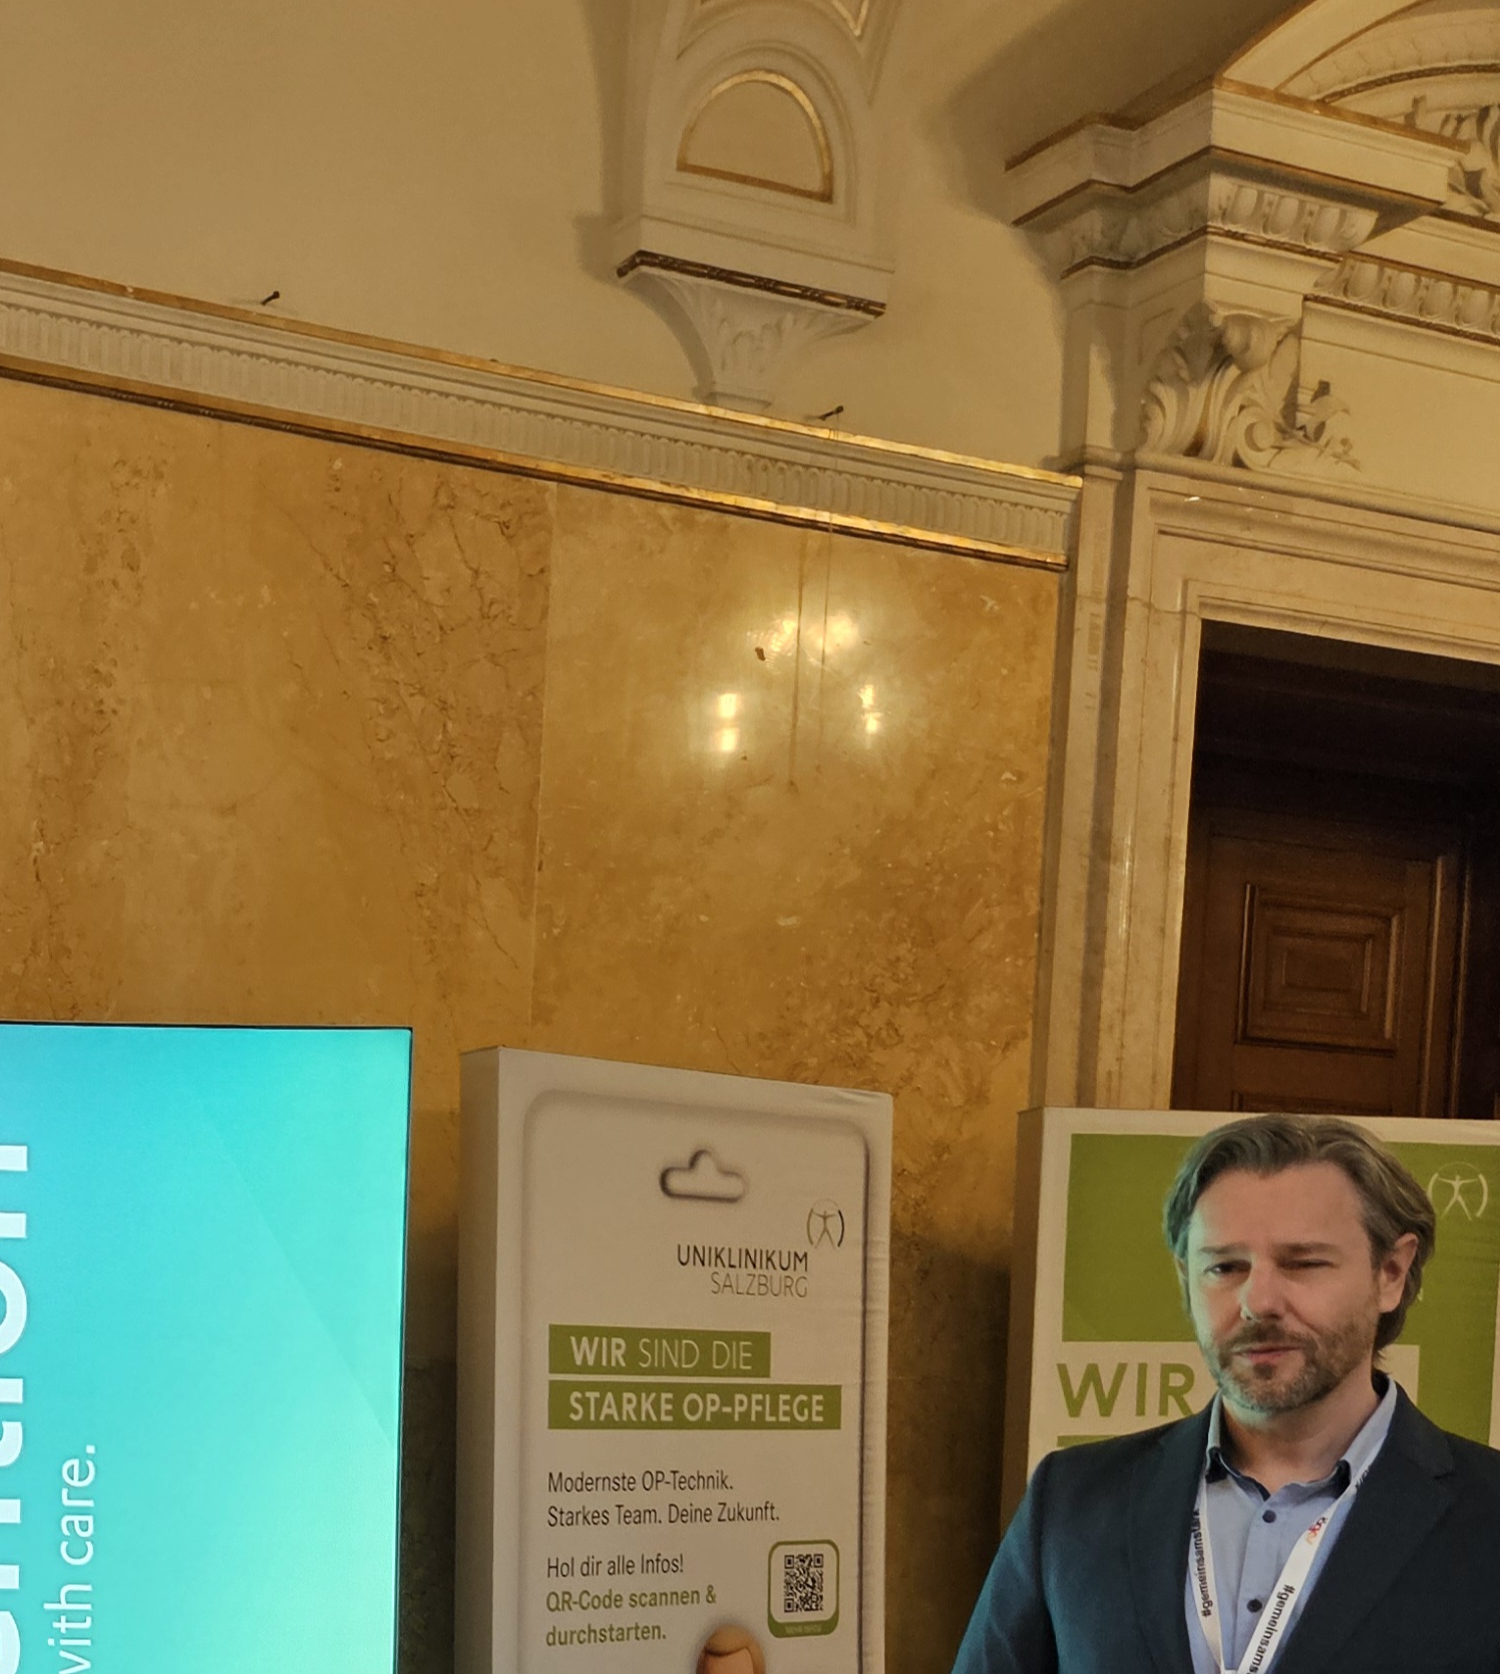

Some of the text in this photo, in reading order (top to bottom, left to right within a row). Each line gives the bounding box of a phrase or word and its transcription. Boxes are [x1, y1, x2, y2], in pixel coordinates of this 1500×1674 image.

[677, 1244, 808, 1272] UNIKLINIKUM
[711, 1271, 808, 1298] SALZBURG
[570, 1336, 752, 1370] WIR SIND DIE
[1056, 1362, 1195, 1417] WIR
[570, 1391, 824, 1422] STARKE OP-PFLEGE
[548, 1470, 733, 1493] Modernste OP-Technik.
[61, 1443, 96, 1566] care.
[547, 1501, 780, 1527] Starkes Team. Deine Zukunft.
[547, 1553, 684, 1578] Hol dir alle Infos!
[546, 1584, 717, 1612] QR-Code scannen &
[546, 1622, 666, 1646] durchstarten.
